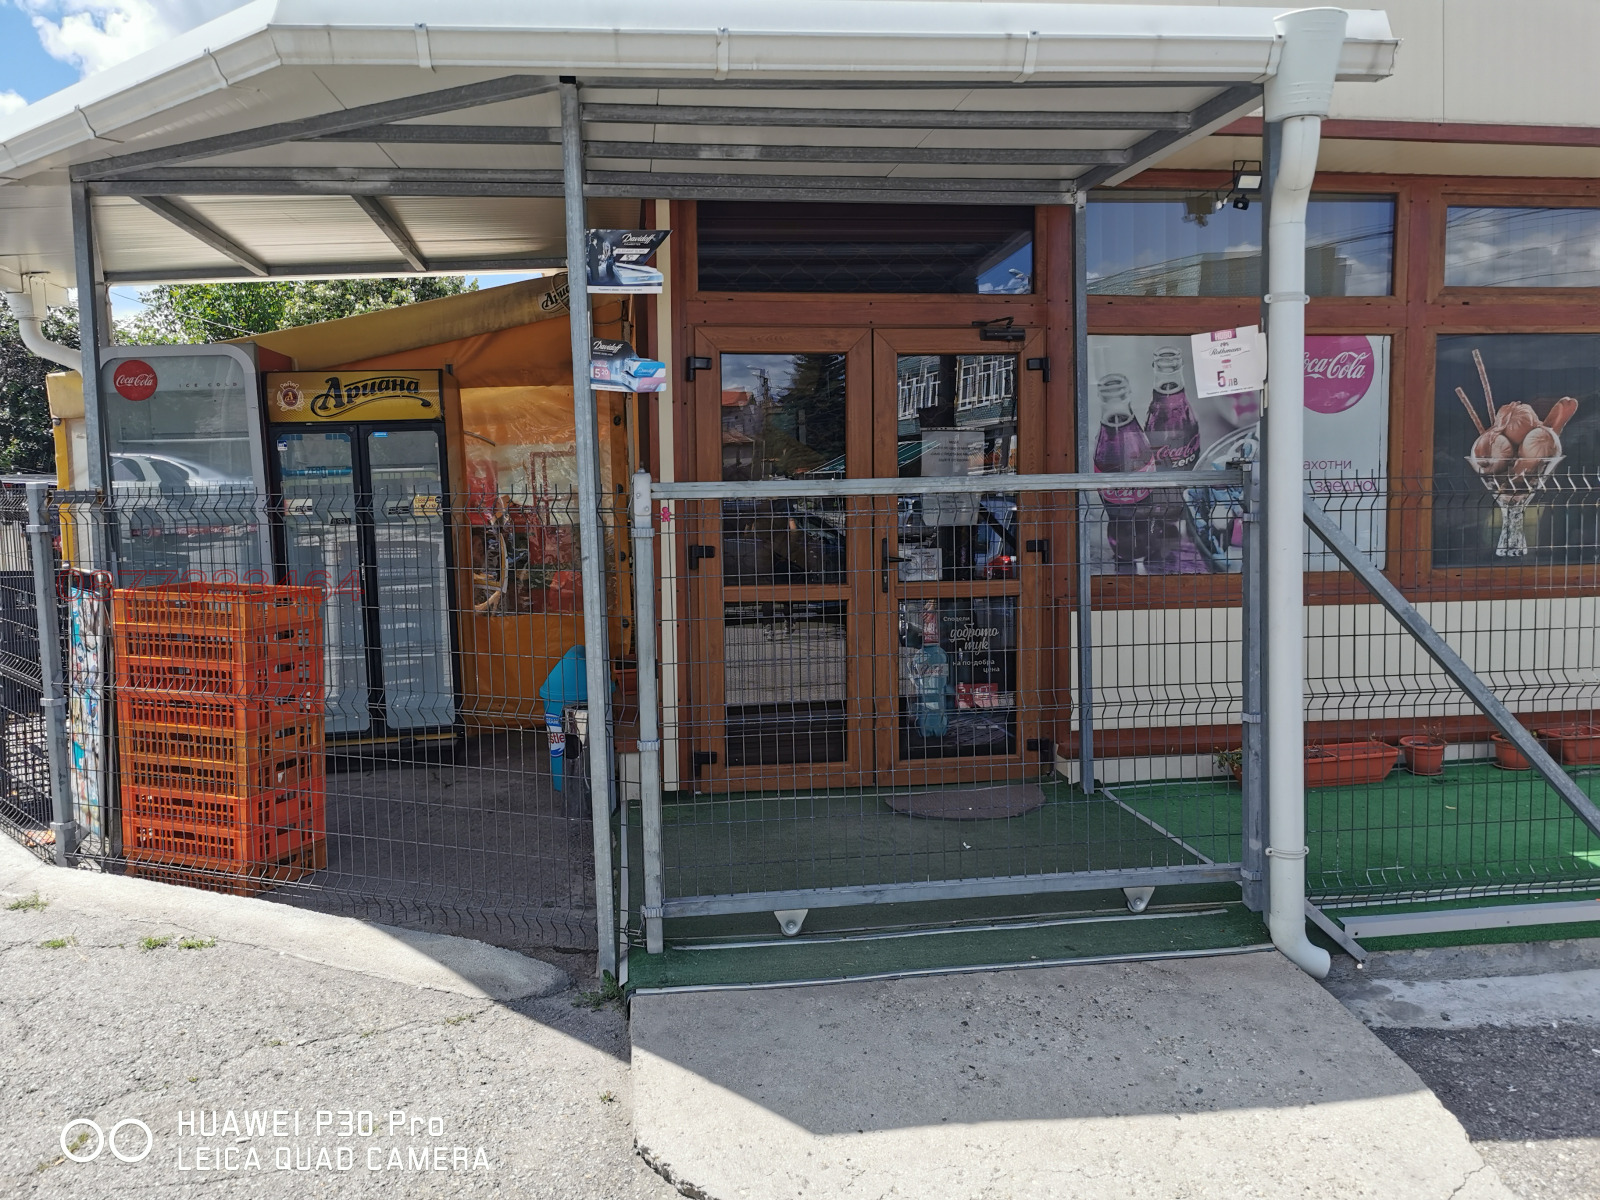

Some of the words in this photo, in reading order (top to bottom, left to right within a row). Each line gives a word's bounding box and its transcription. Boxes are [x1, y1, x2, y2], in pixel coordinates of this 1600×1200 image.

[621, 232, 657, 245] Davidoff
[593, 340, 624, 353] Davidoff
[1210, 347, 1242, 356] Rothmans
[116, 373, 154, 387] Coca-Cola
[1217, 370, 1226, 388] 5
[312, 376, 424, 412] Ариана
[1171, 453, 1196, 468] zero
[1303, 460, 1352, 470] ахотни
[550, 733, 566, 744] stle
